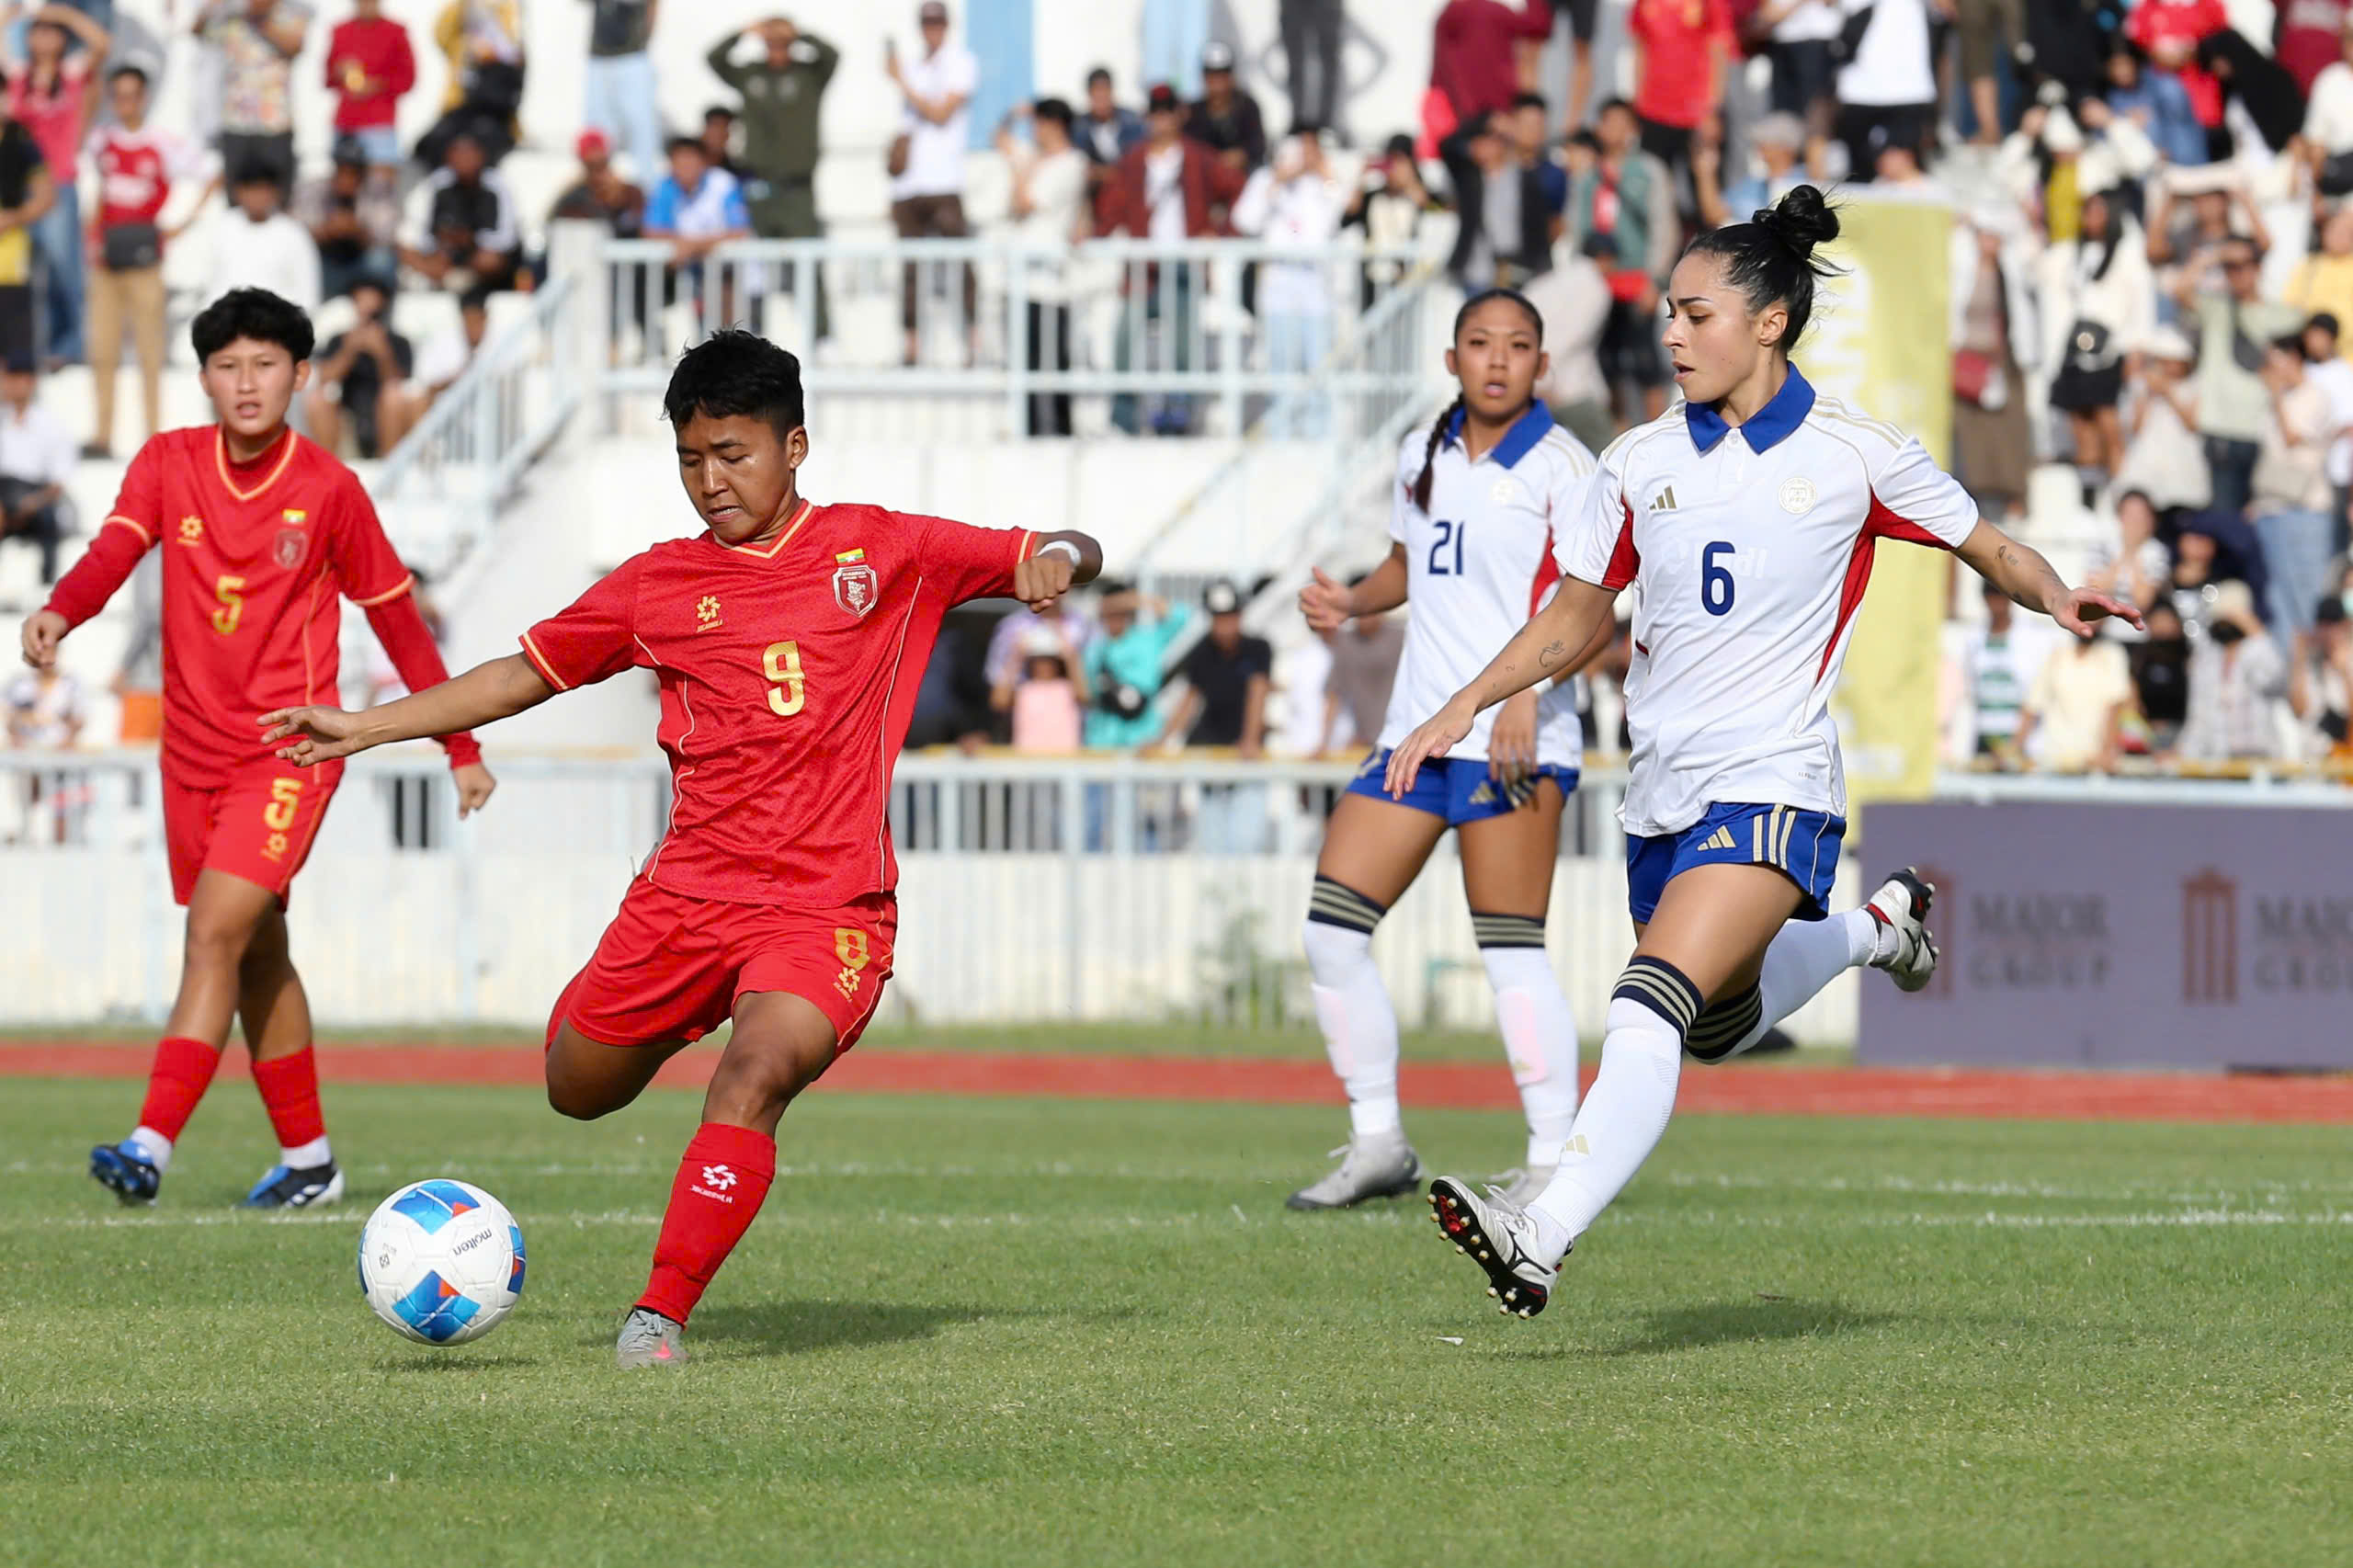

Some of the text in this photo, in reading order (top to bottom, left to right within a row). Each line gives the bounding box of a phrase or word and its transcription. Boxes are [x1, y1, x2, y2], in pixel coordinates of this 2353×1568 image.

[1428, 519, 1465, 575] 21
[212, 574, 246, 635] 5
[1701, 540, 1736, 617] 6
[762, 640, 805, 717] 9
[264, 778, 302, 831] 5
[452, 1228, 493, 1256] molten
